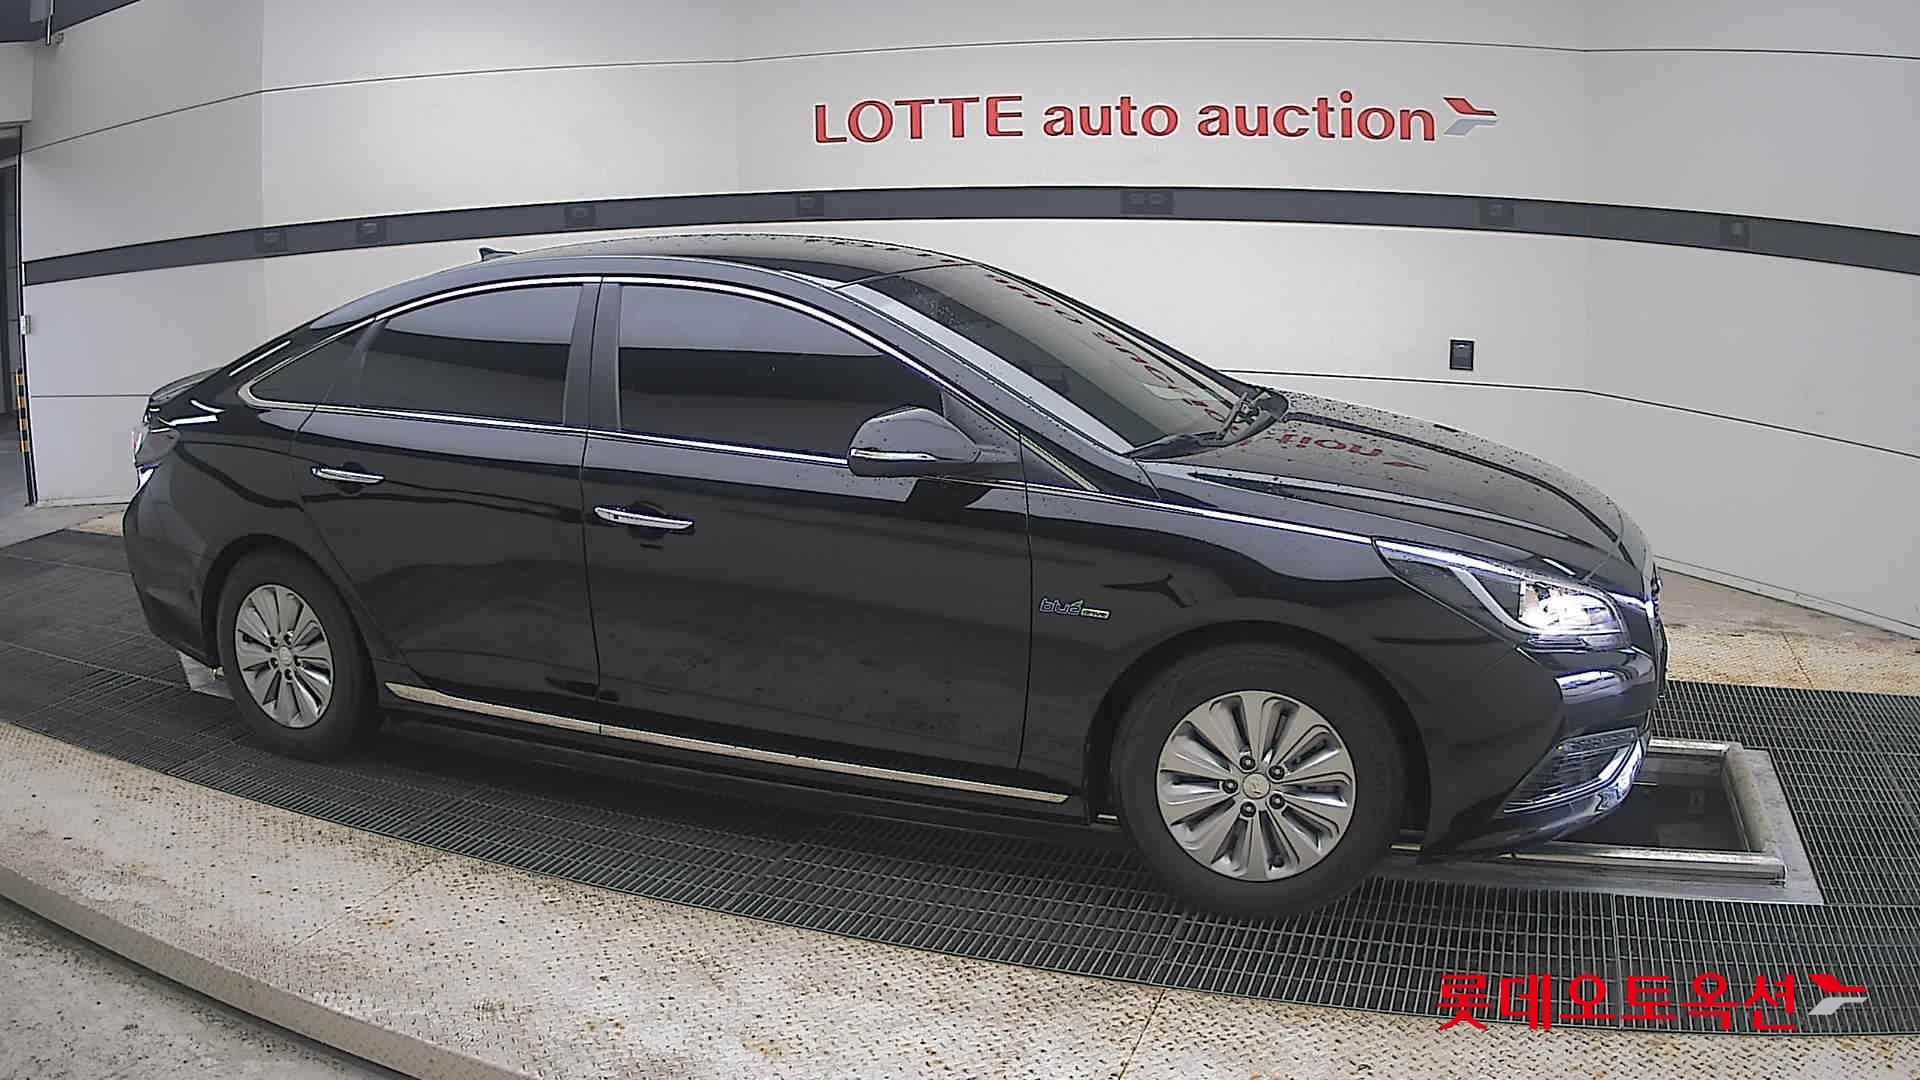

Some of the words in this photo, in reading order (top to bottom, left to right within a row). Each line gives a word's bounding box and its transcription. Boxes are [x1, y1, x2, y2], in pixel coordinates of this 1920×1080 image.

[814, 95, 1022, 144] LOTTE
[1042, 96, 1180, 137] auto
[1198, 91, 1437, 142] auction
